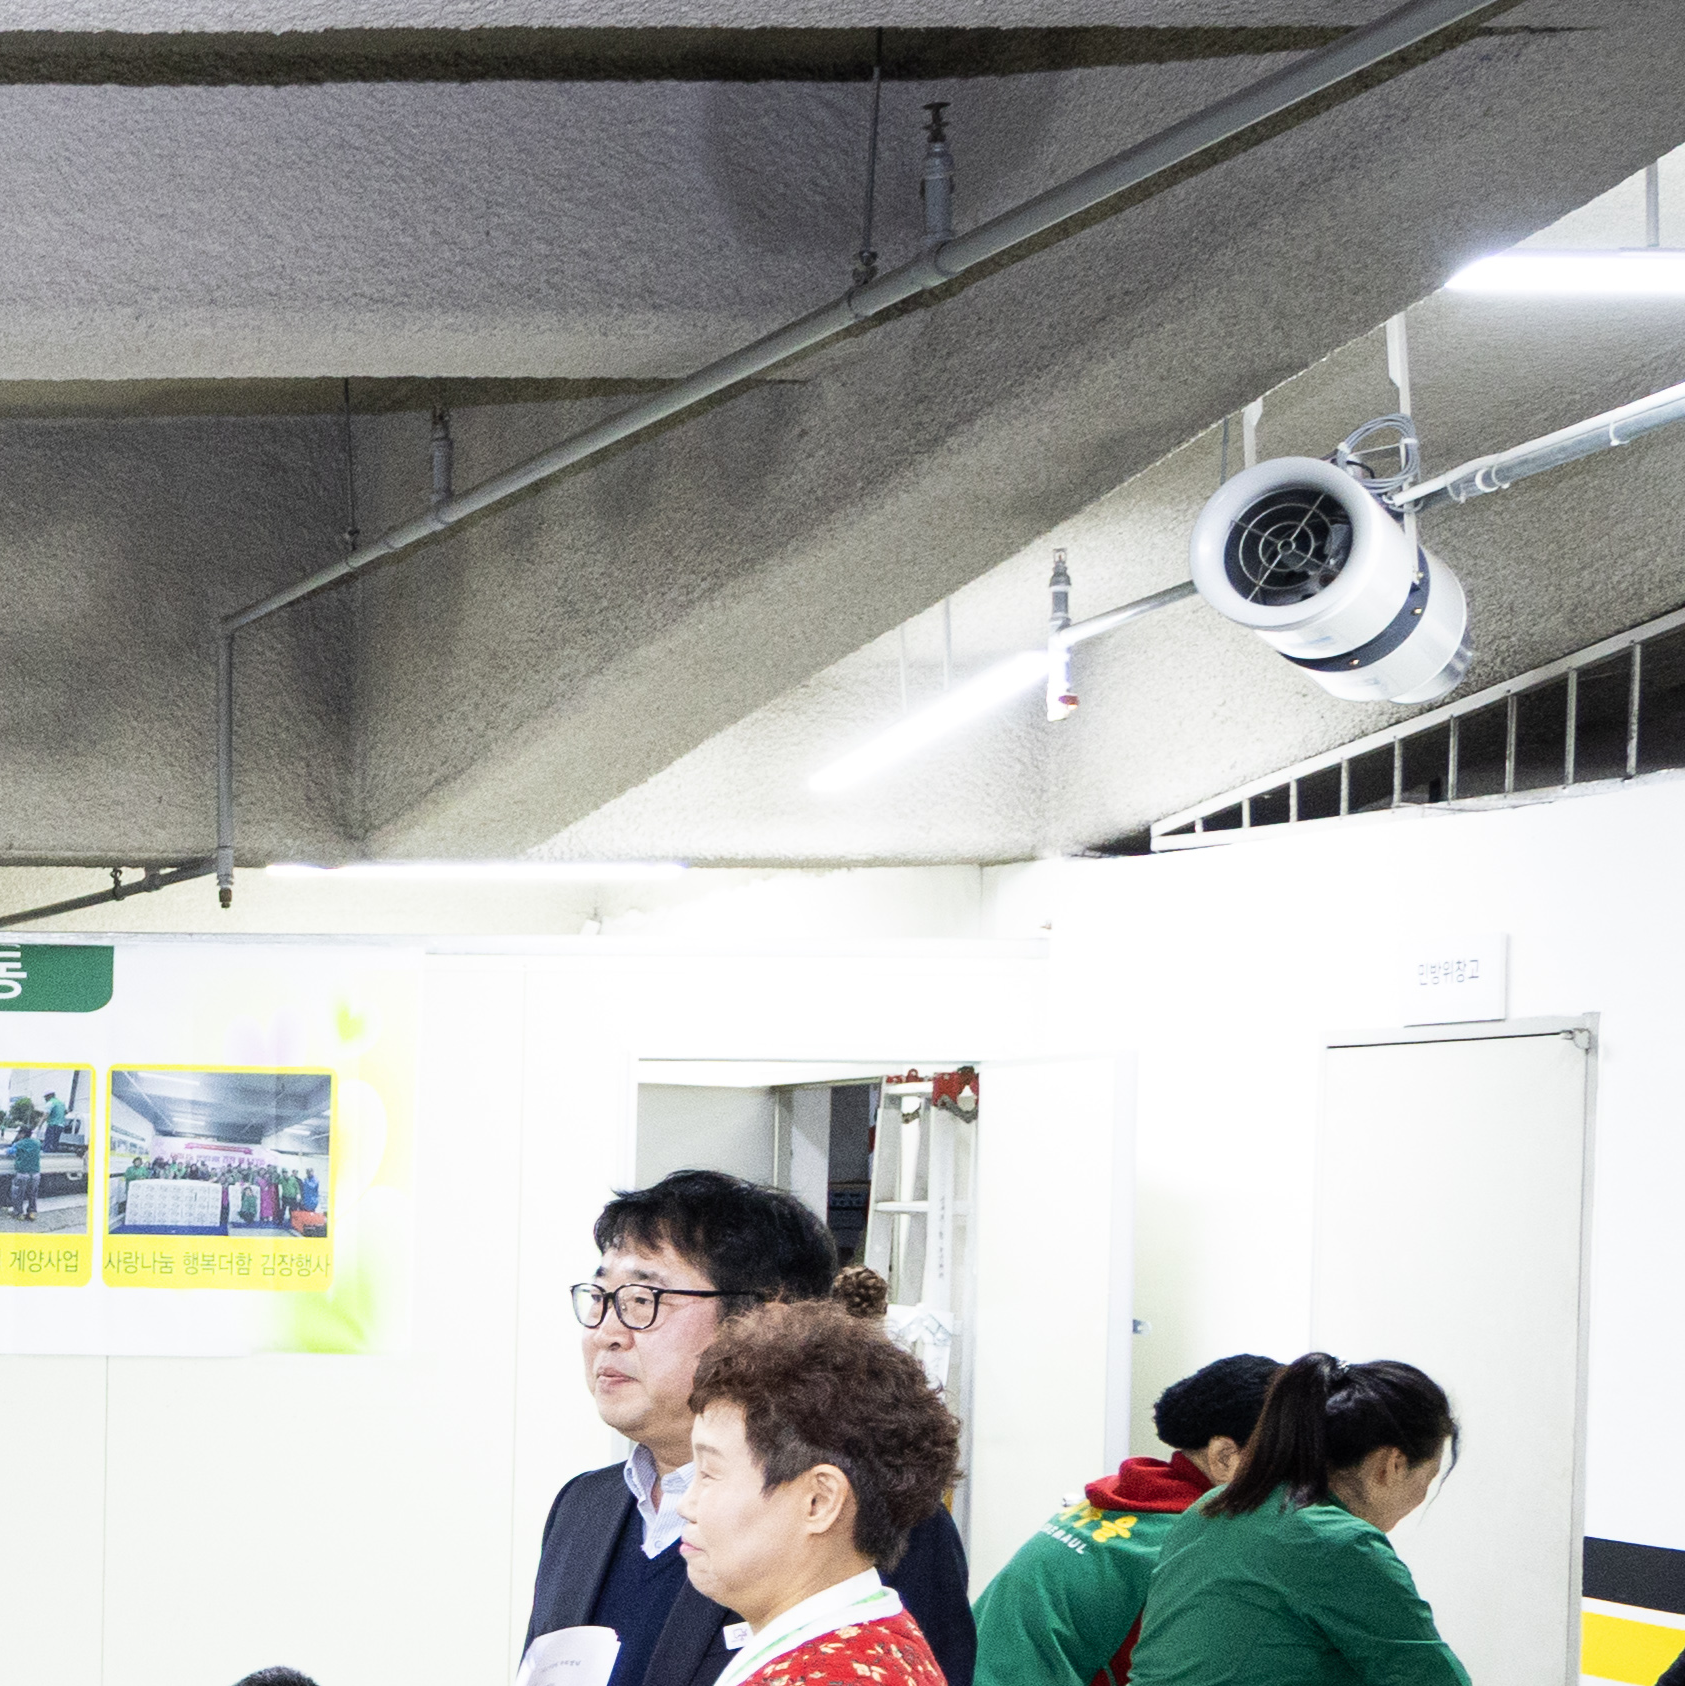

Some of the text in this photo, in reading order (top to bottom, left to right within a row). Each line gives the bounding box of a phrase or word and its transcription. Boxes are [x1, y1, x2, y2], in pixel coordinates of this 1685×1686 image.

[9, 1249, 79, 1274] 게양사업
[104, 1250, 332, 1278] 사랑나눔 행복더함 김장행사
